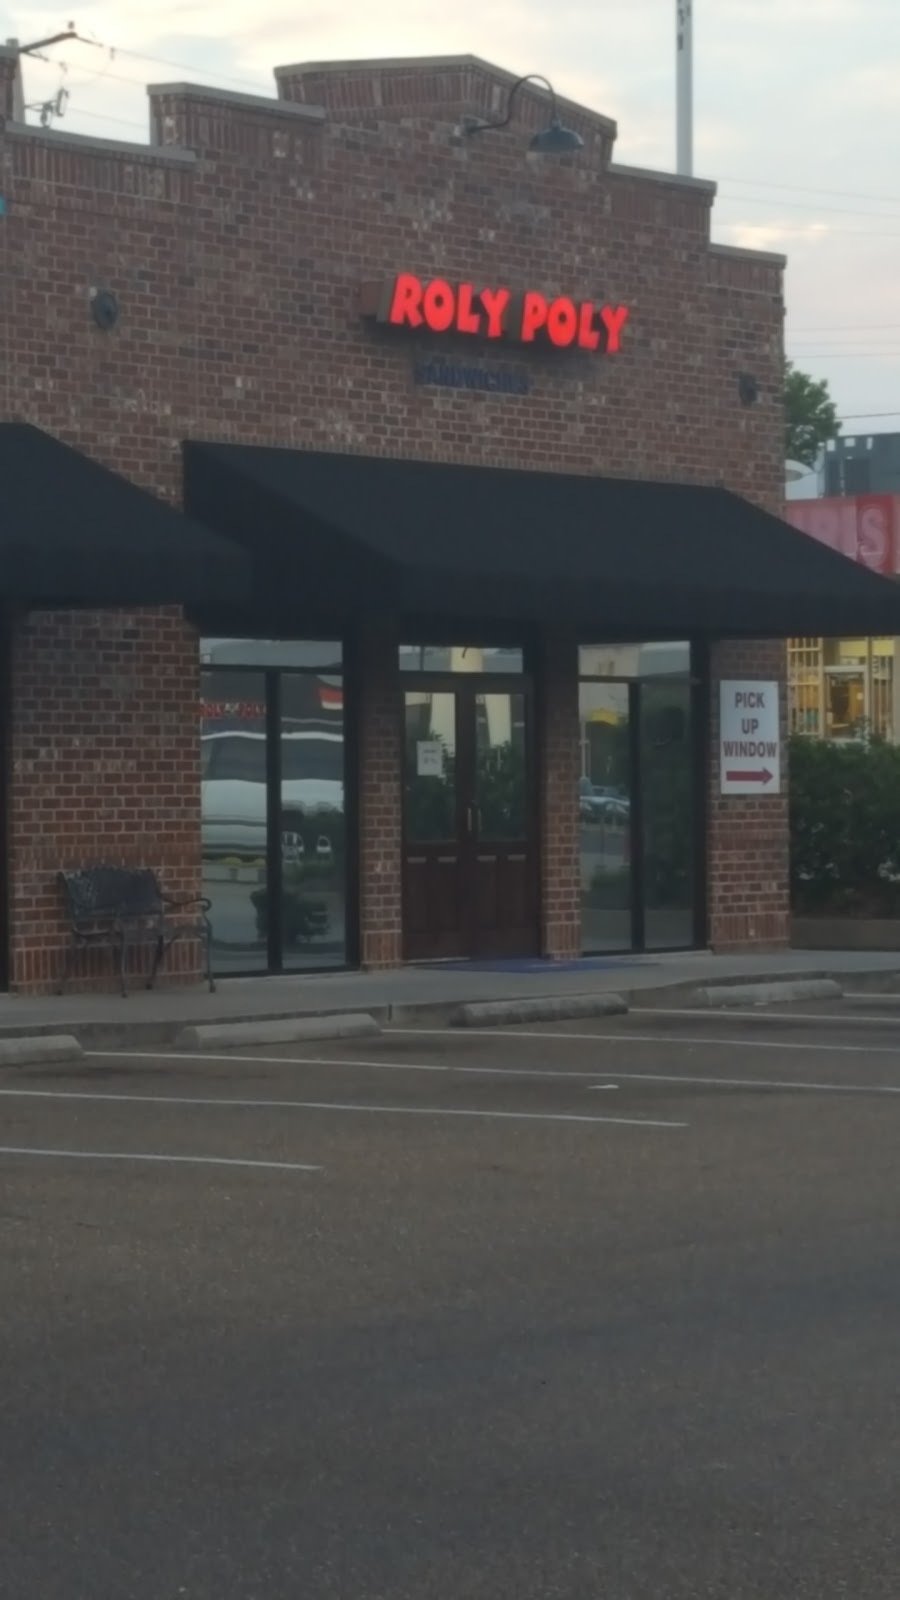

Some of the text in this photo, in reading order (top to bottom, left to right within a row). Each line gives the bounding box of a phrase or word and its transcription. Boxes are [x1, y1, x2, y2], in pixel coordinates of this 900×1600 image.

[390, 272, 628, 353] ROLY POLY
[735, 691, 765, 708] PICK
[741, 718, 759, 735] UP
[723, 741, 777, 758] WINDOW
